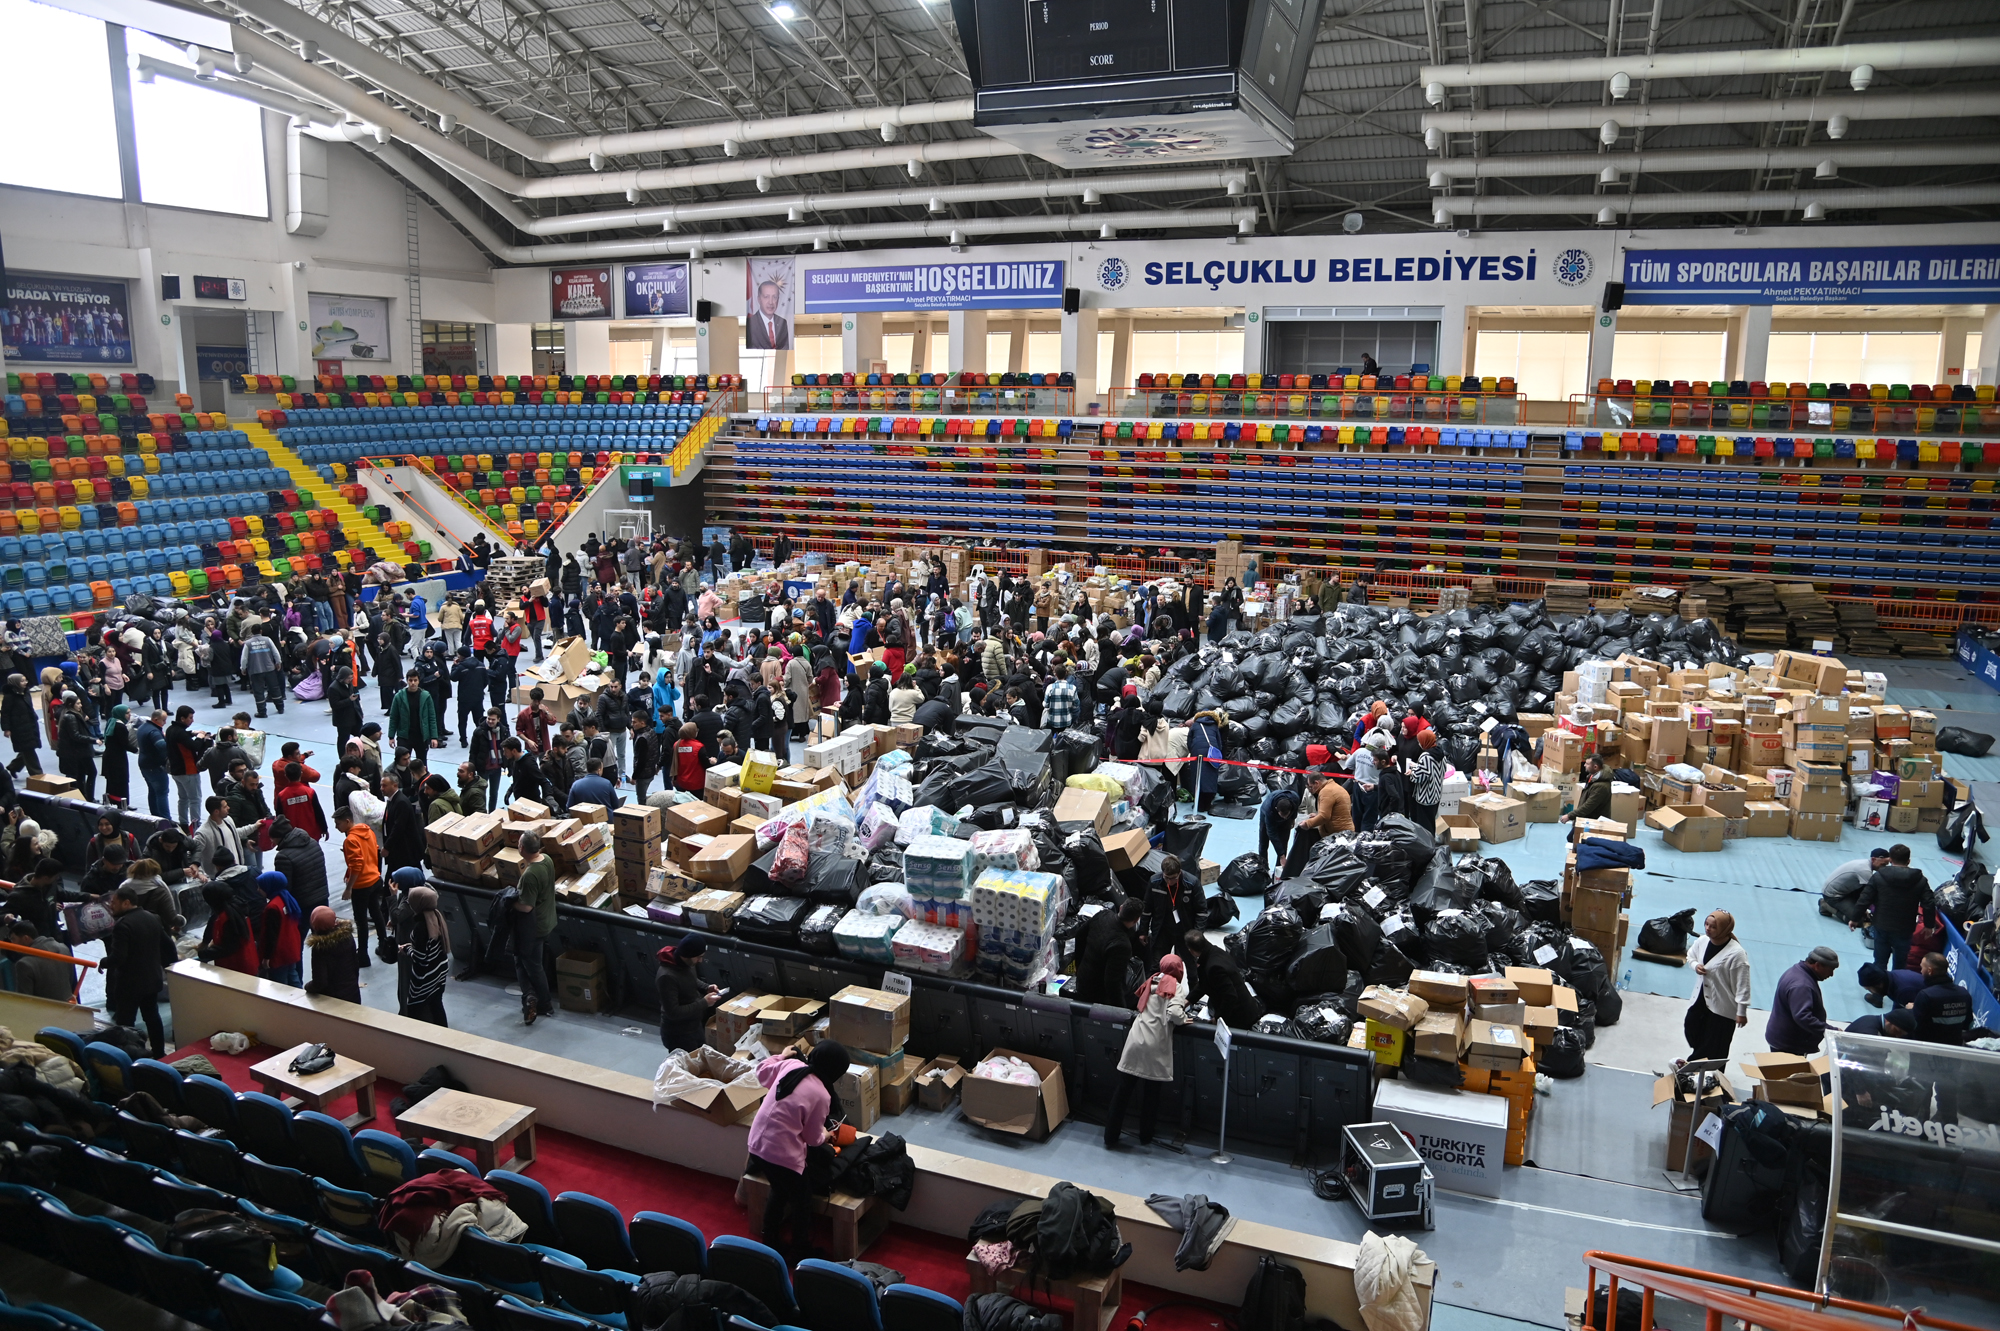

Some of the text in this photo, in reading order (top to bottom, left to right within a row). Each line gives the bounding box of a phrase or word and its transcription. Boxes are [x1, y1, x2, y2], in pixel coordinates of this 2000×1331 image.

[1089, 21, 1109, 32] PERIOD
[1089, 54, 1115, 67] SCORE
[1144, 249, 1537, 290] SELÇUKLU BELEDİYESİ
[1630, 259, 1671, 283] TÜM
[1676, 262, 1802, 283] SPORCULARA
[1808, 259, 1921, 285] BAŞARILAR
[811, 274, 849, 284] SELÇUKLU
[17, 282, 92, 293] SELÇUKLU'NUN YILDIZLARI
[1763, 286, 1861, 296] Ahmet PEKYATIRMACI
[52, 291, 110, 305] YETİŞİYOR
[905, 294, 971, 304] Ahmet PEKYATIRMACI
[893, 977, 906, 986] TIBBİ
[1419, 1135, 1485, 1156] TÜRKİYE
[1419, 1147, 1485, 1168] SİGORTA
[1452, 1168, 1487, 1179] adında.
